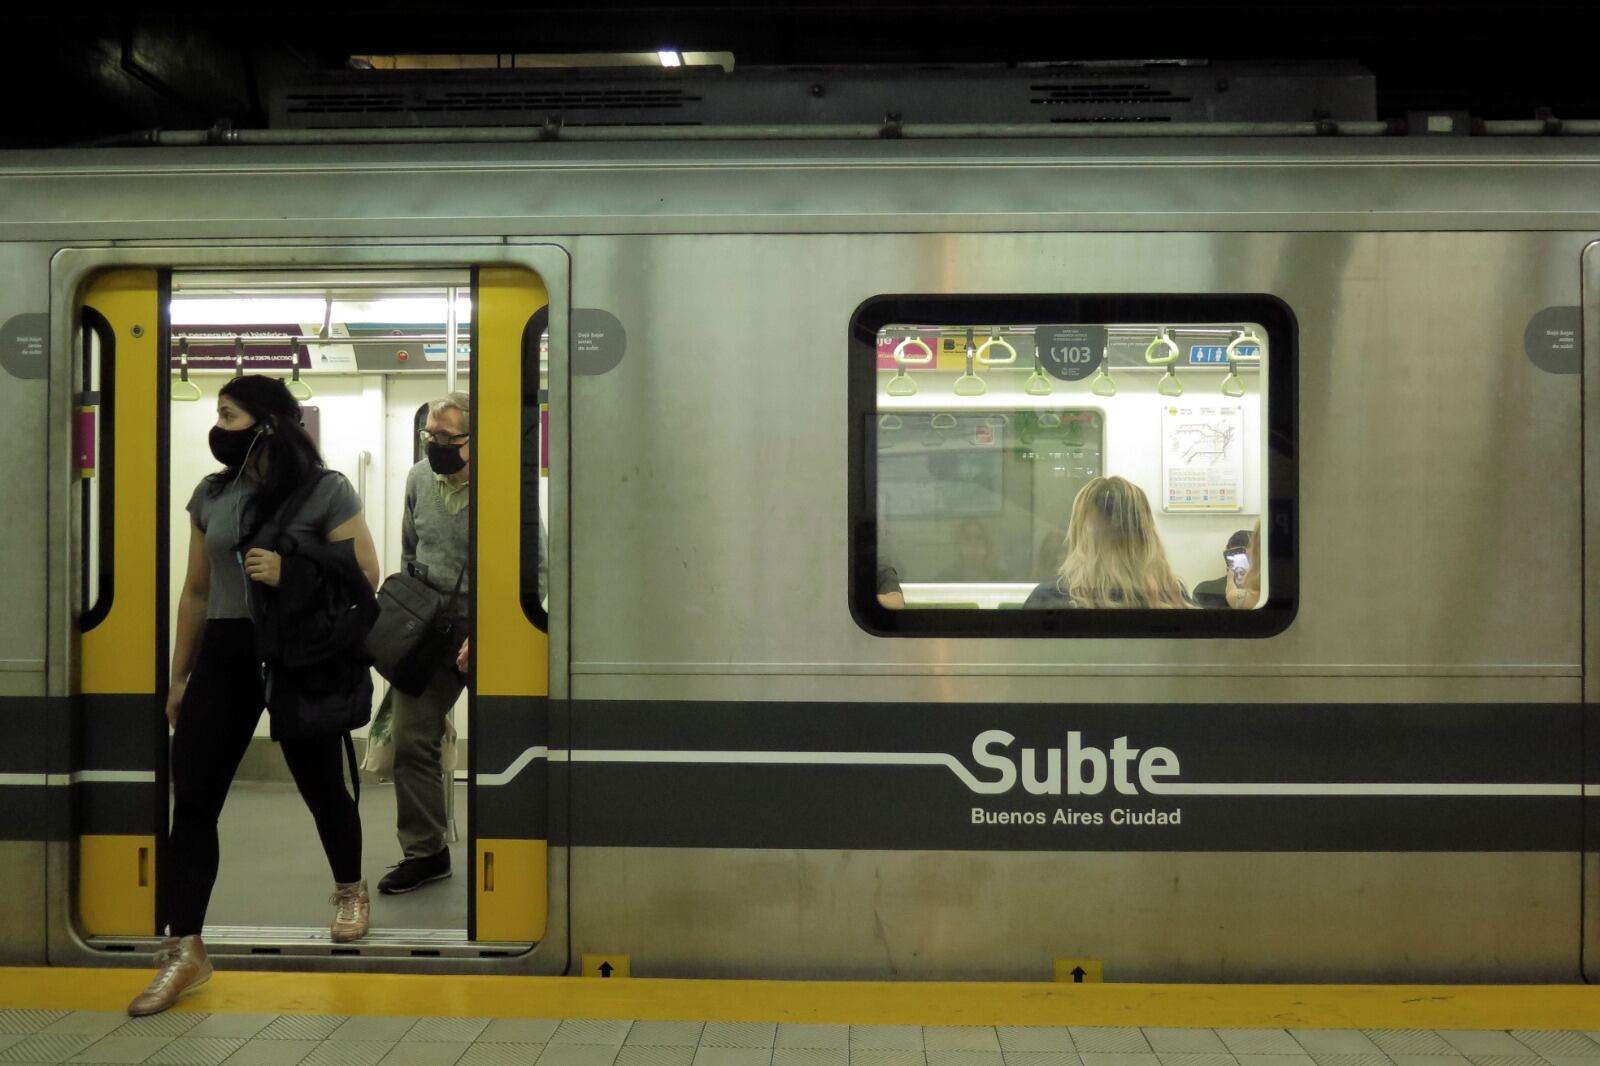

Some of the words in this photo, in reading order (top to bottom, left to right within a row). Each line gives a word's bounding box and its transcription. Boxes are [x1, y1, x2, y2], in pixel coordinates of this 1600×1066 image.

[1060, 346, 1091, 363] 103
[971, 729, 1181, 795] Subte
[971, 808, 1046, 825] Buenos
[1053, 808, 1104, 825] Aires
[1110, 808, 1181, 825] Ciudad
